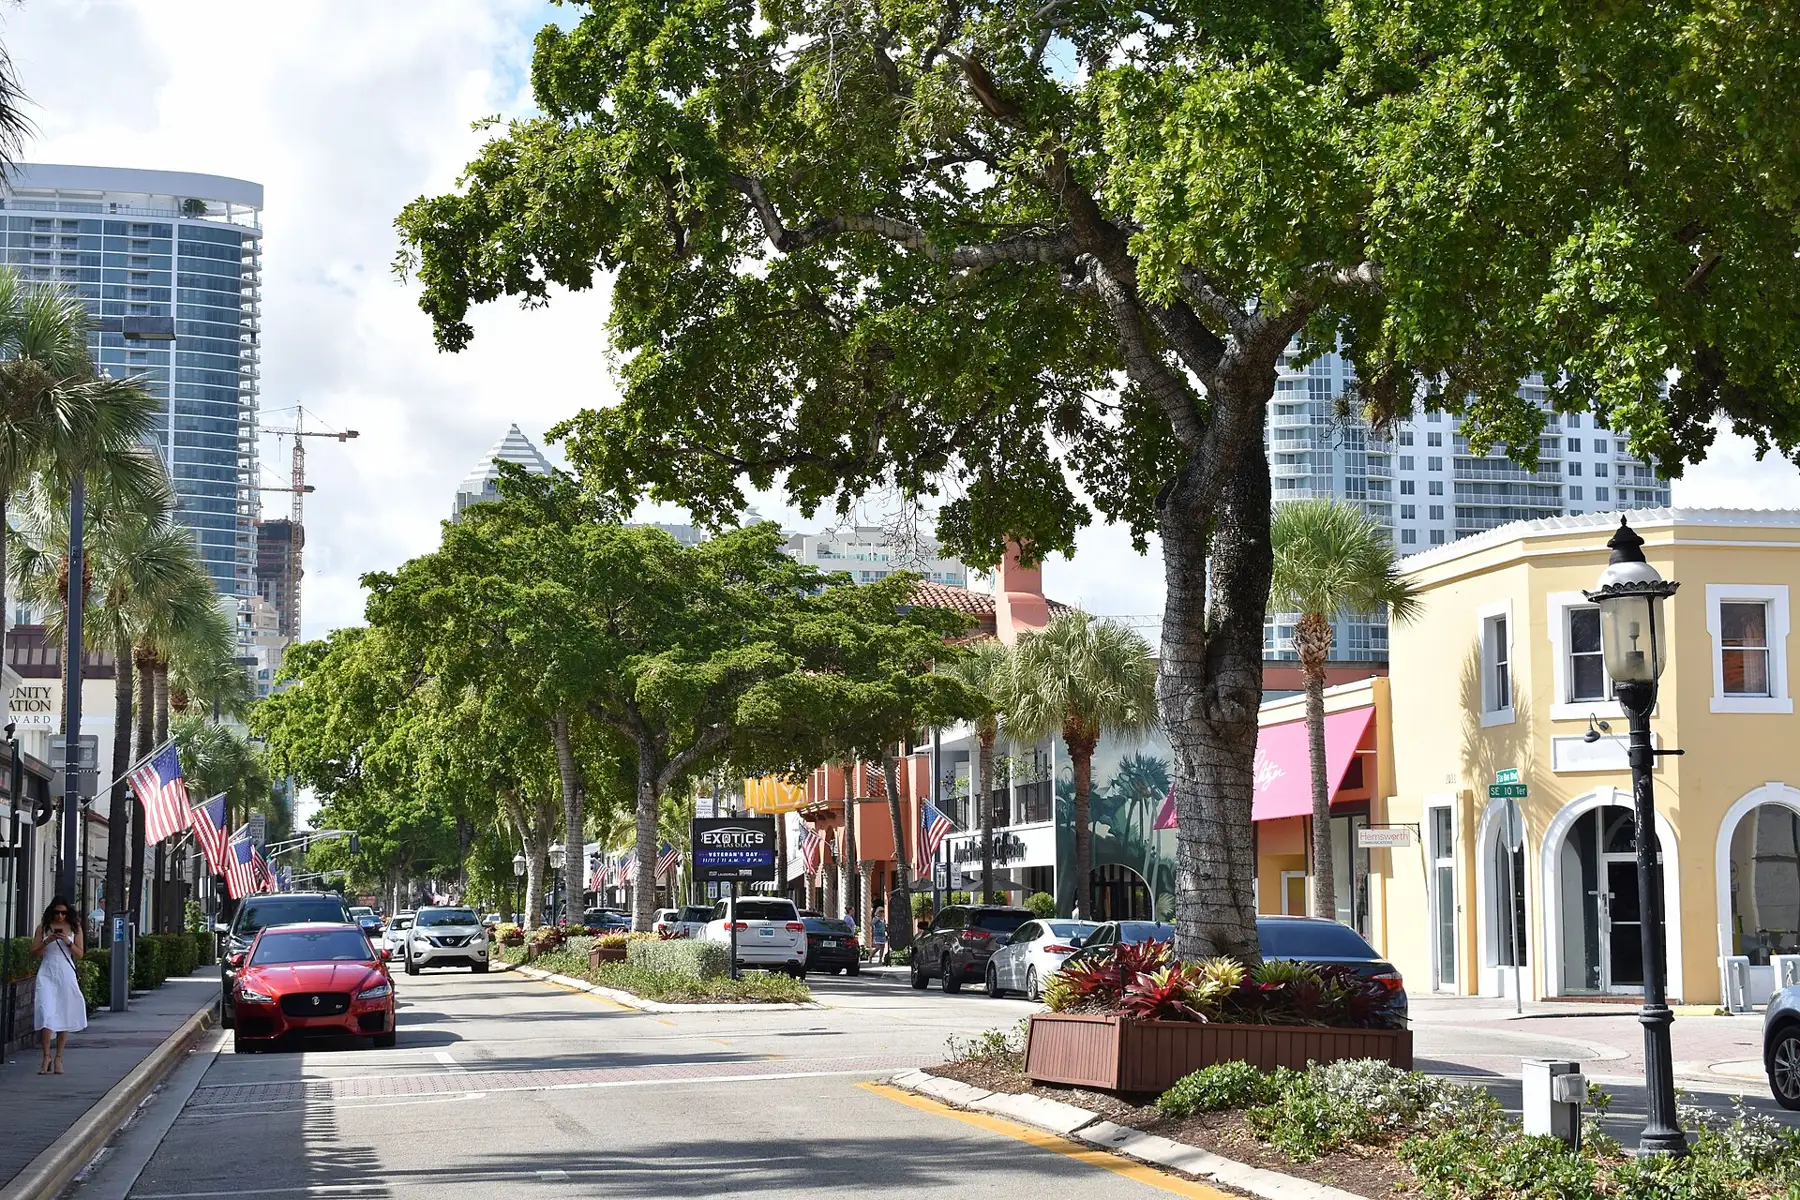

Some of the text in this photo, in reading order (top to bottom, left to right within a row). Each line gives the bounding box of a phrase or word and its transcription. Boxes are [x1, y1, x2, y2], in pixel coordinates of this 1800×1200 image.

[1490, 786, 1526, 796] SE 10 Ter
[703, 833, 764, 844] EXOTICS
[1360, 831, 1409, 841] Hemsworth
